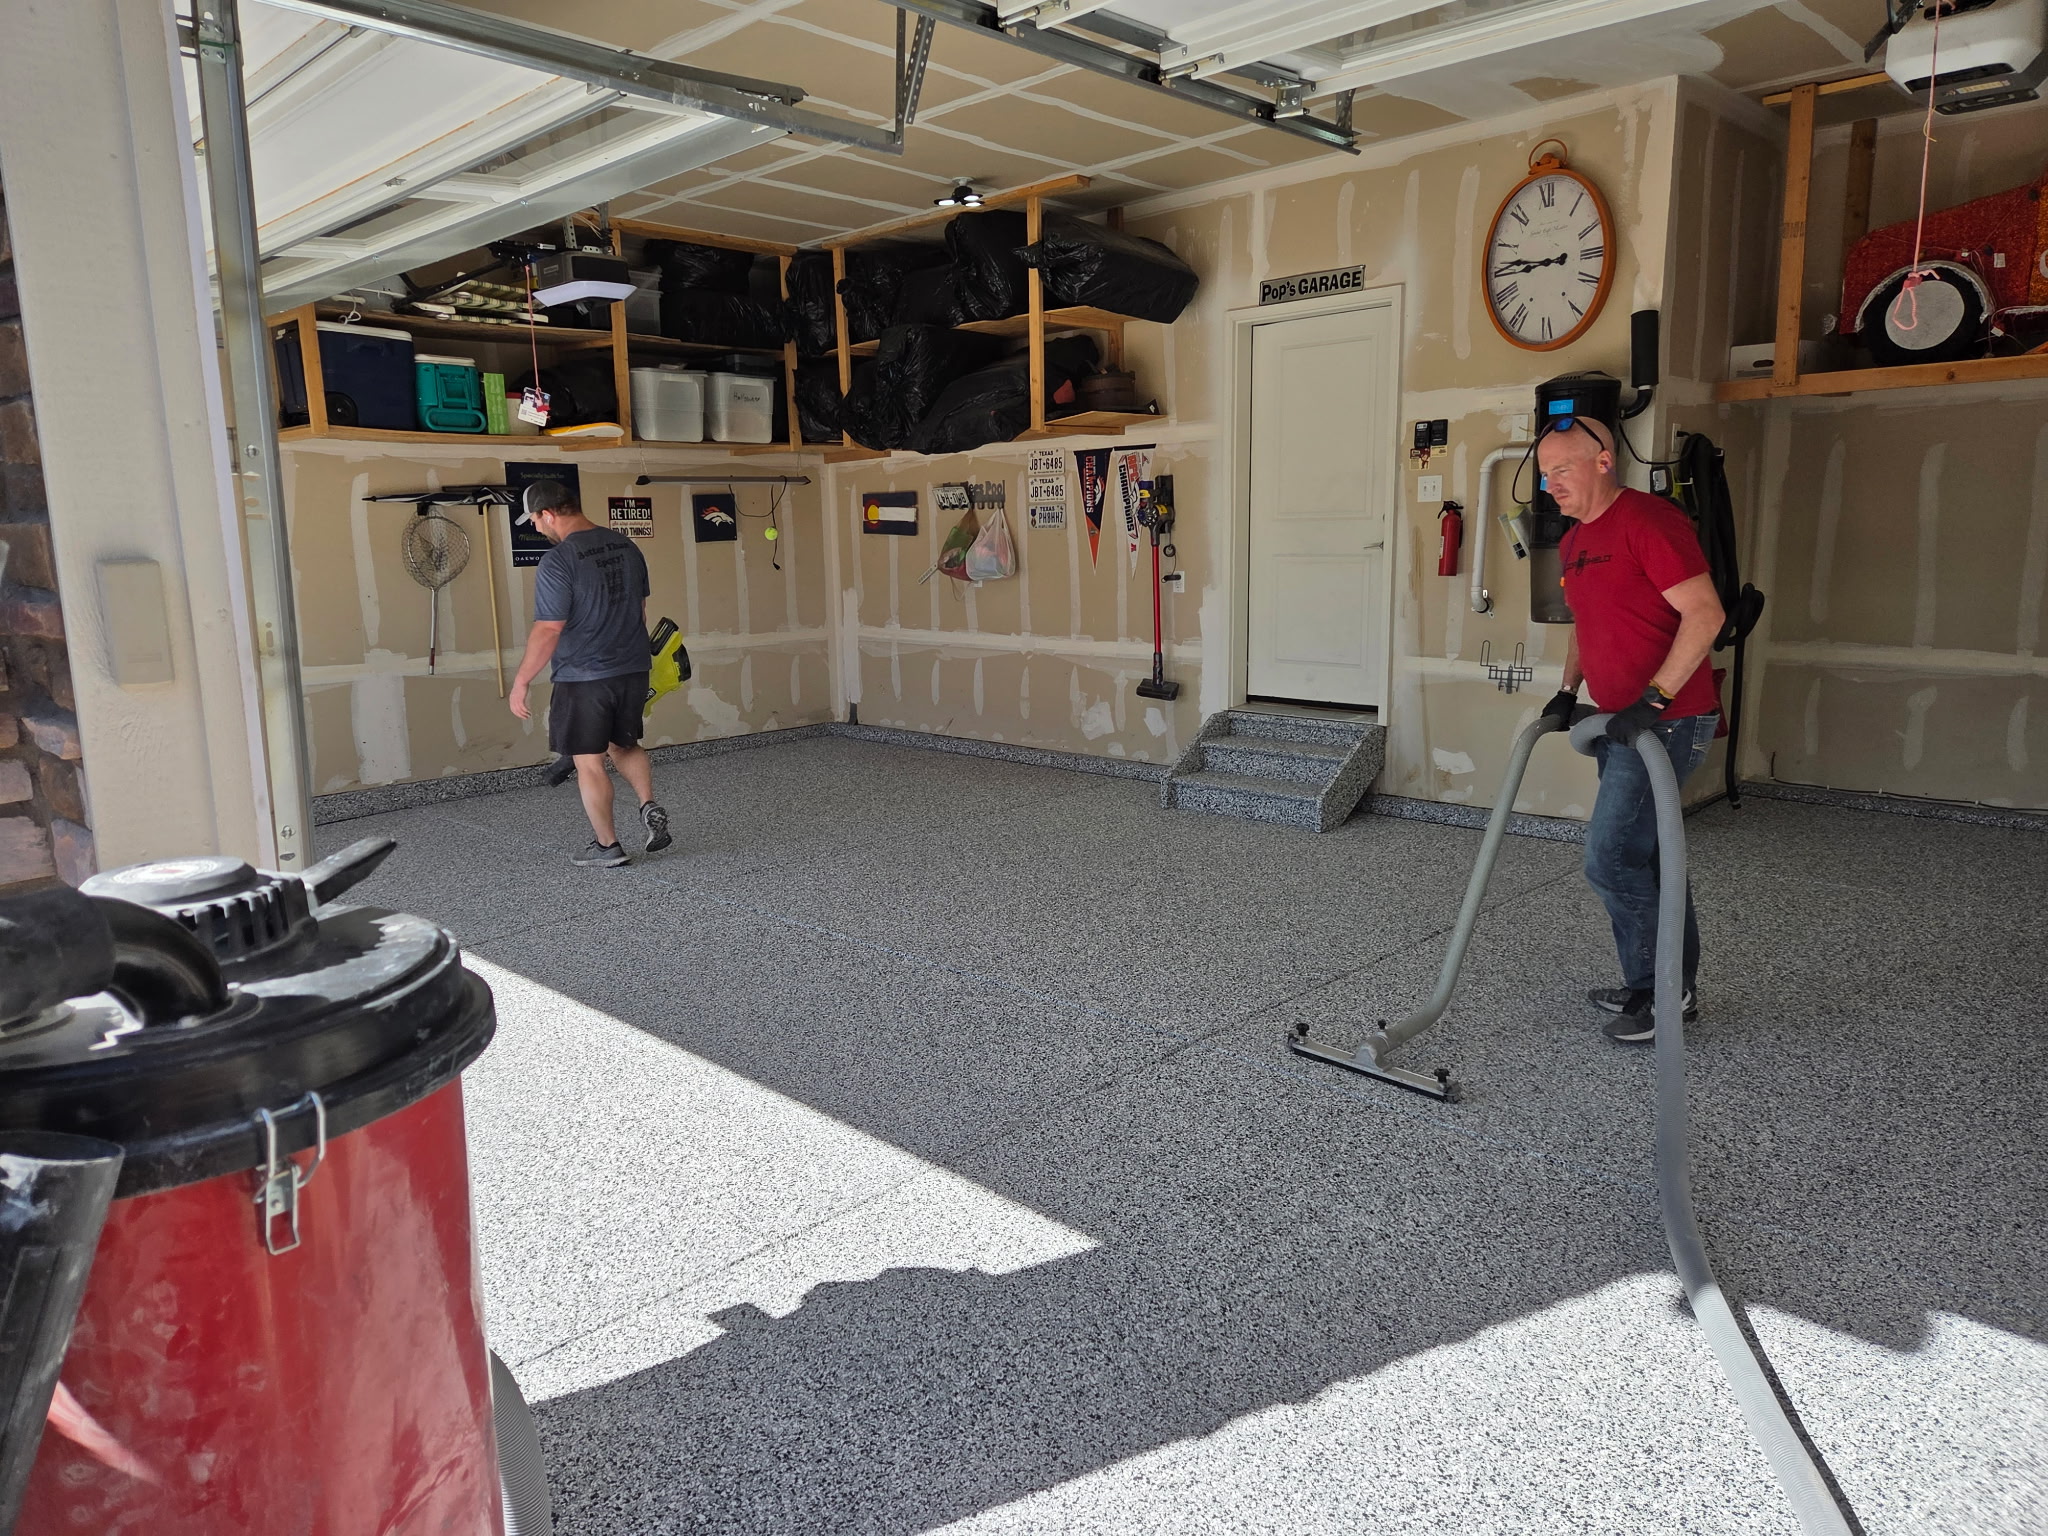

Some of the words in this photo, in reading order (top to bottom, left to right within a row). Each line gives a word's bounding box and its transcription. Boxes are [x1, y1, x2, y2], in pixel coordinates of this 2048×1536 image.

[1261, 281, 1296, 302] Pop's
[1298, 270, 1362, 295] GARAGE
[1085, 456, 1095, 513] CHAMPIONS
[624, 499, 635, 508] I'M
[1118, 464, 1135, 532] CHAMPIONS
[610, 508, 651, 520] RETIRED!
[629, 527, 652, 537] THINGS!
